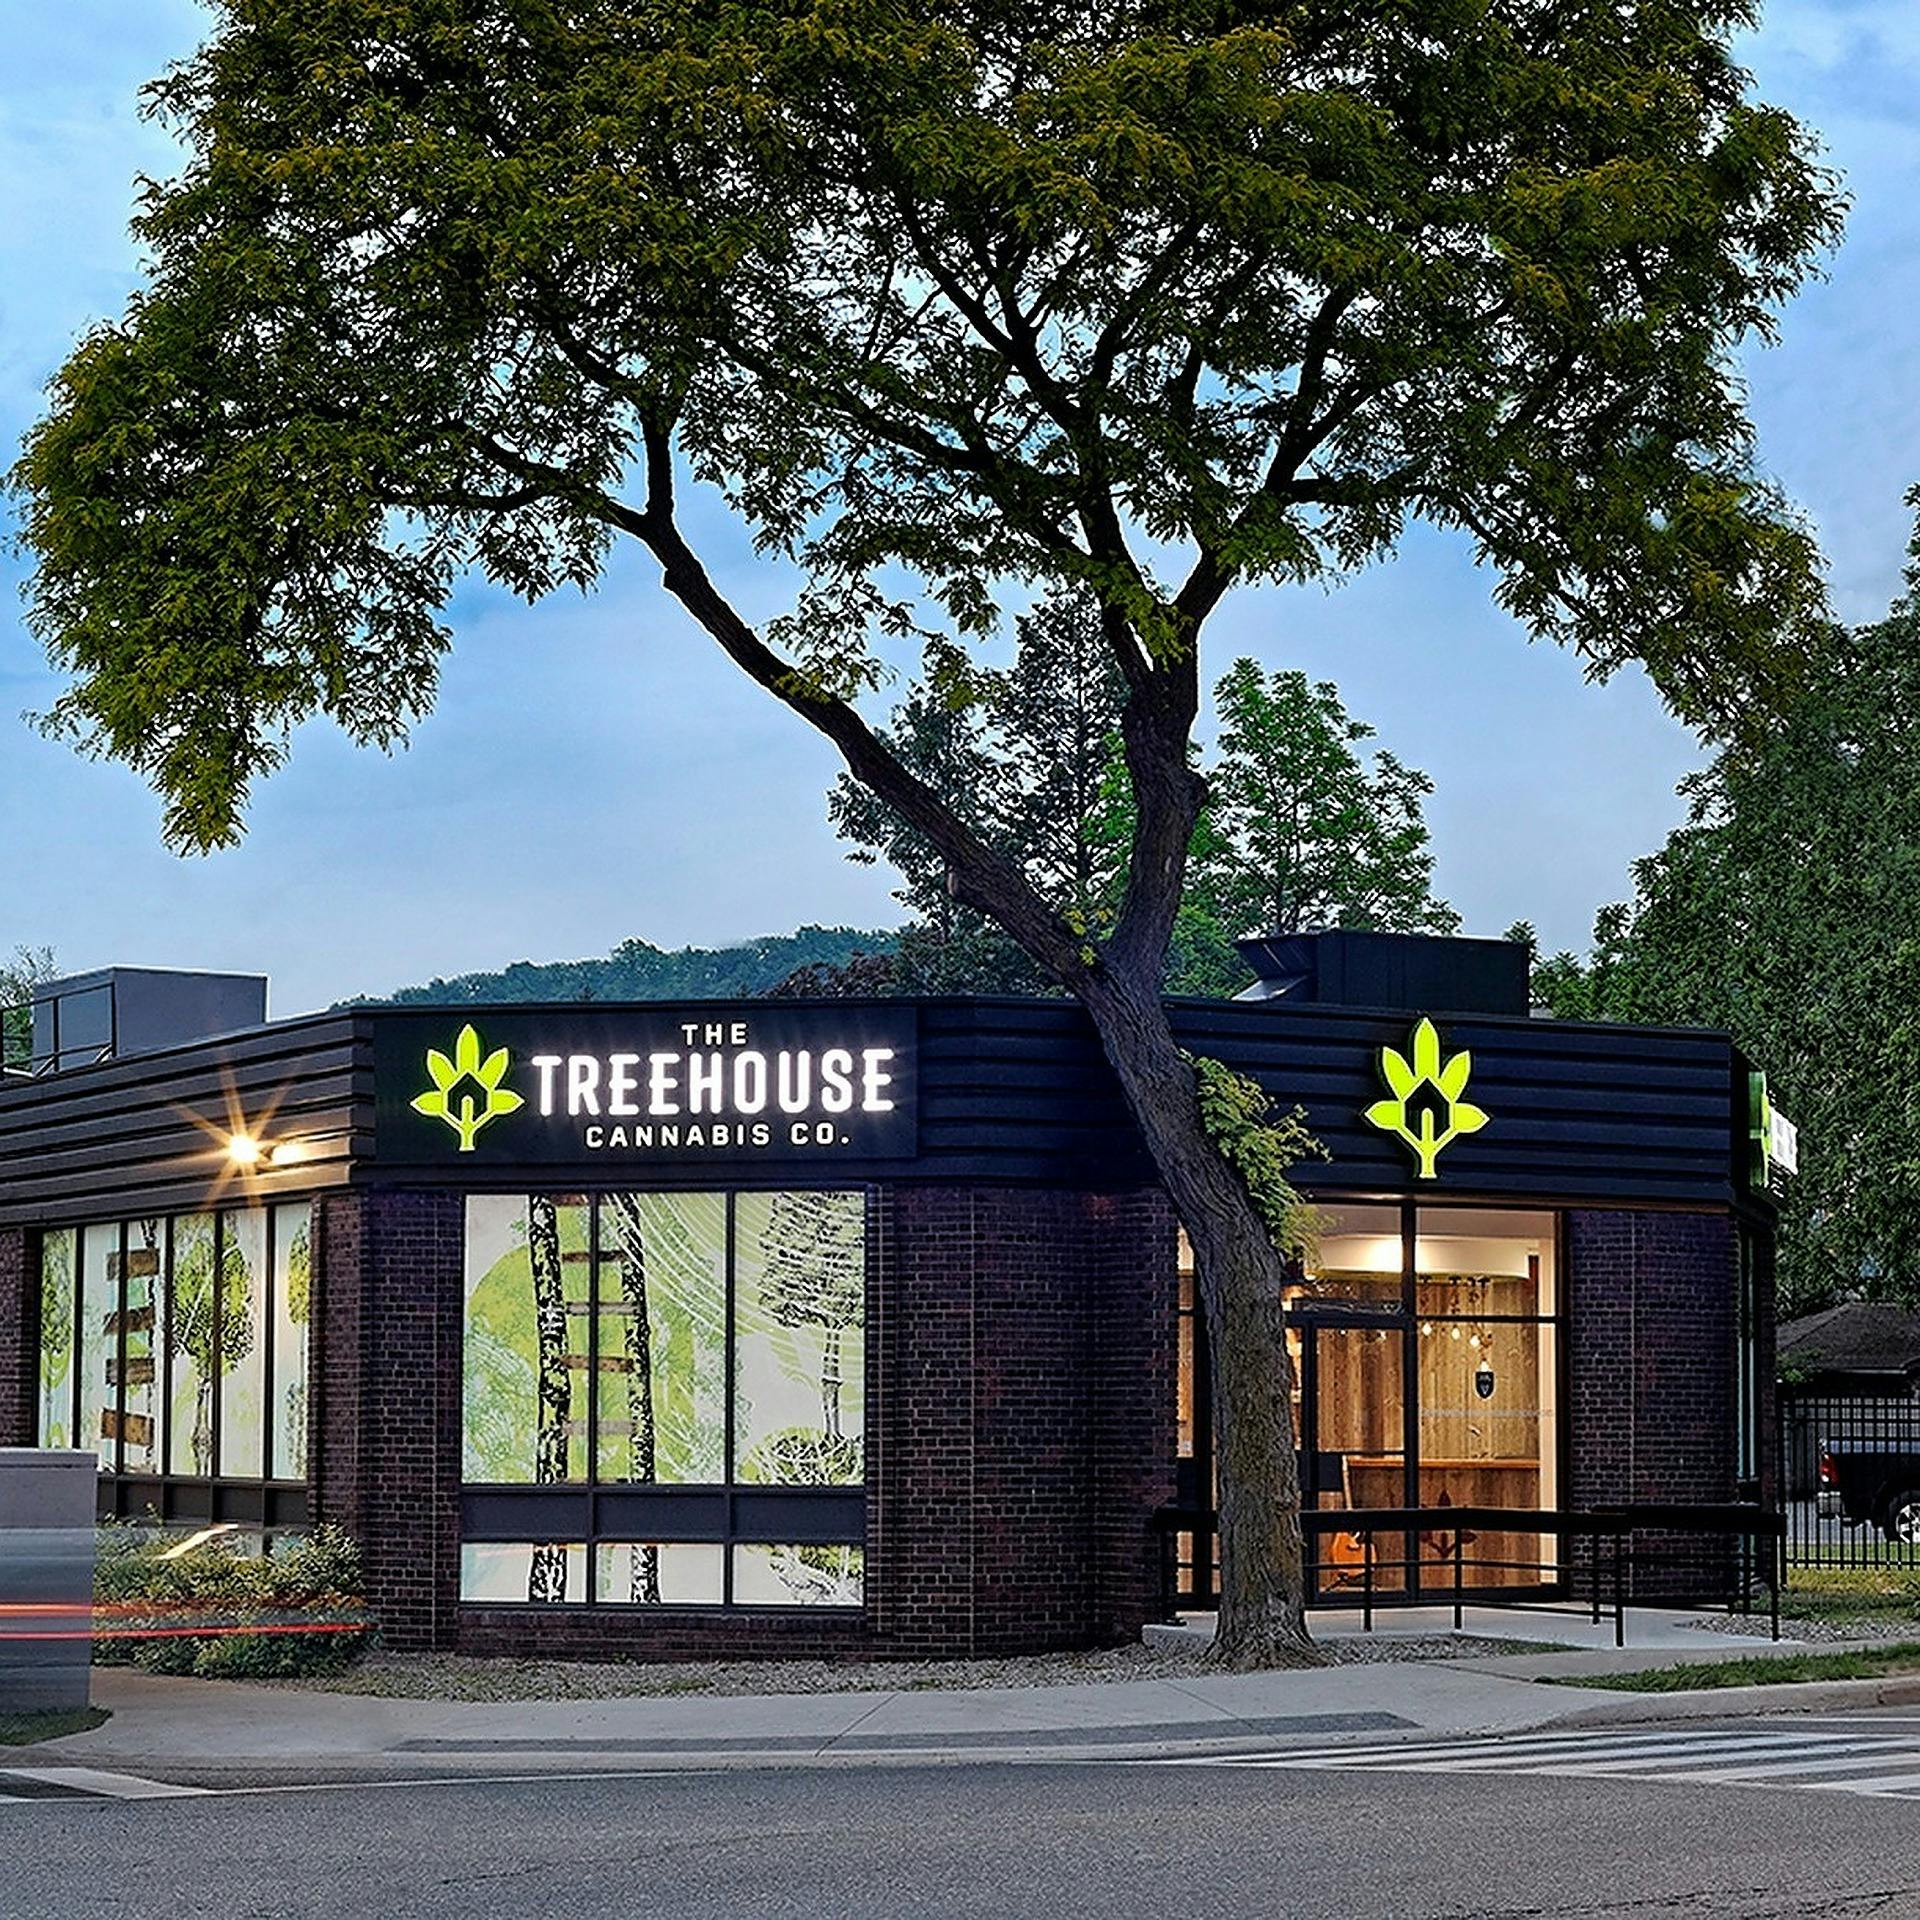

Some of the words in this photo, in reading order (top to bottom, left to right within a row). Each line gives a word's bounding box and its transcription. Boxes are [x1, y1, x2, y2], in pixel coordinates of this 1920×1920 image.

[681, 1023, 747, 1045] THE
[531, 1048, 894, 1116] TREEHOUSE
[586, 1123, 769, 1147] CANNABIS
[791, 1122, 849, 1145] CO.
